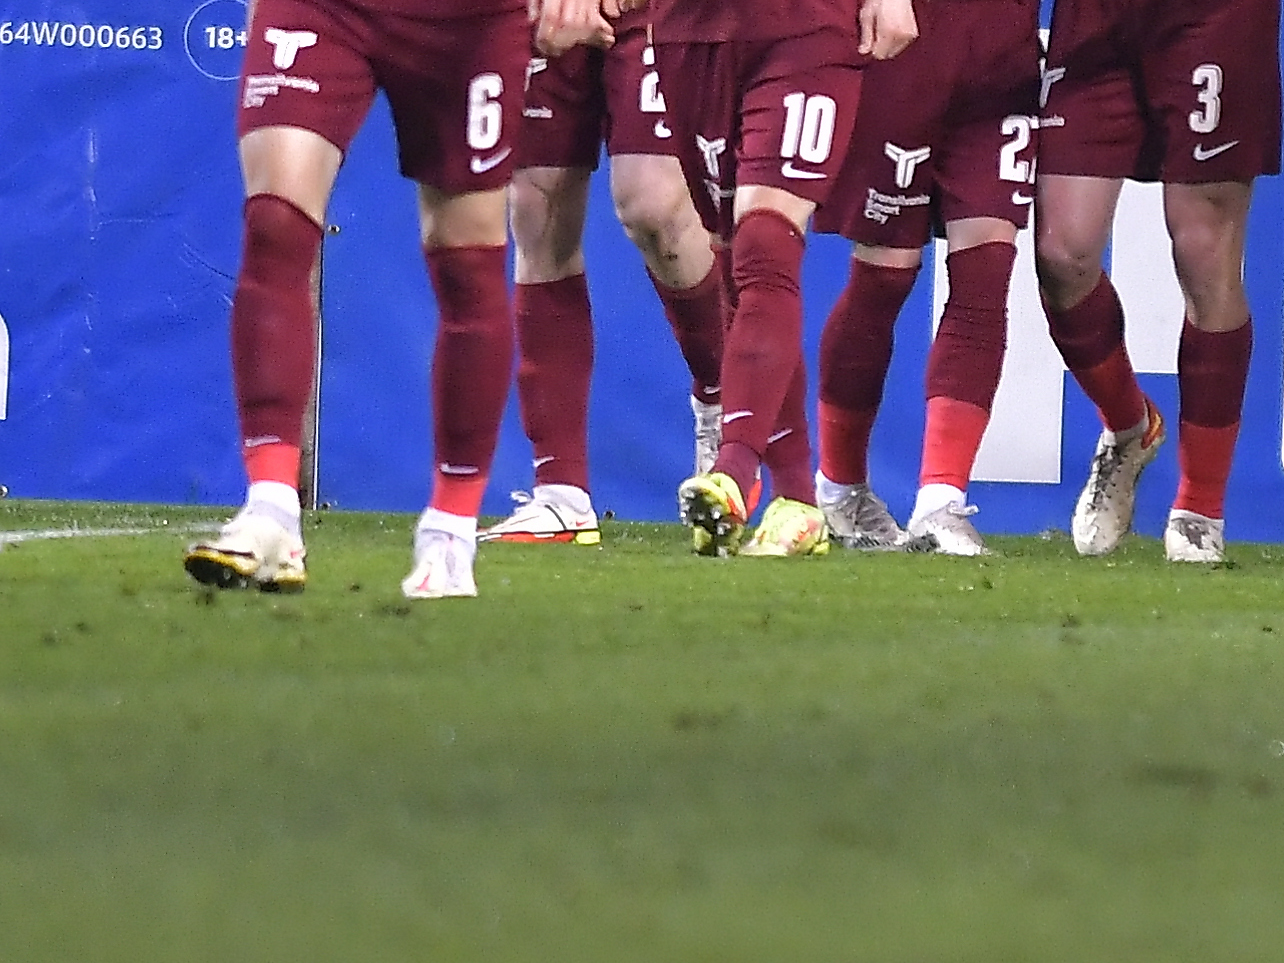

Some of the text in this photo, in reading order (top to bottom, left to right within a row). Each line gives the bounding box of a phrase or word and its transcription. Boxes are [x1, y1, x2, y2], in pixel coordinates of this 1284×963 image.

[0, 21, 163, 50] 64W000663
[467, 72, 503, 150] 6
[781, 92, 836, 163] 10
[1188, 63, 1223, 133] 3
